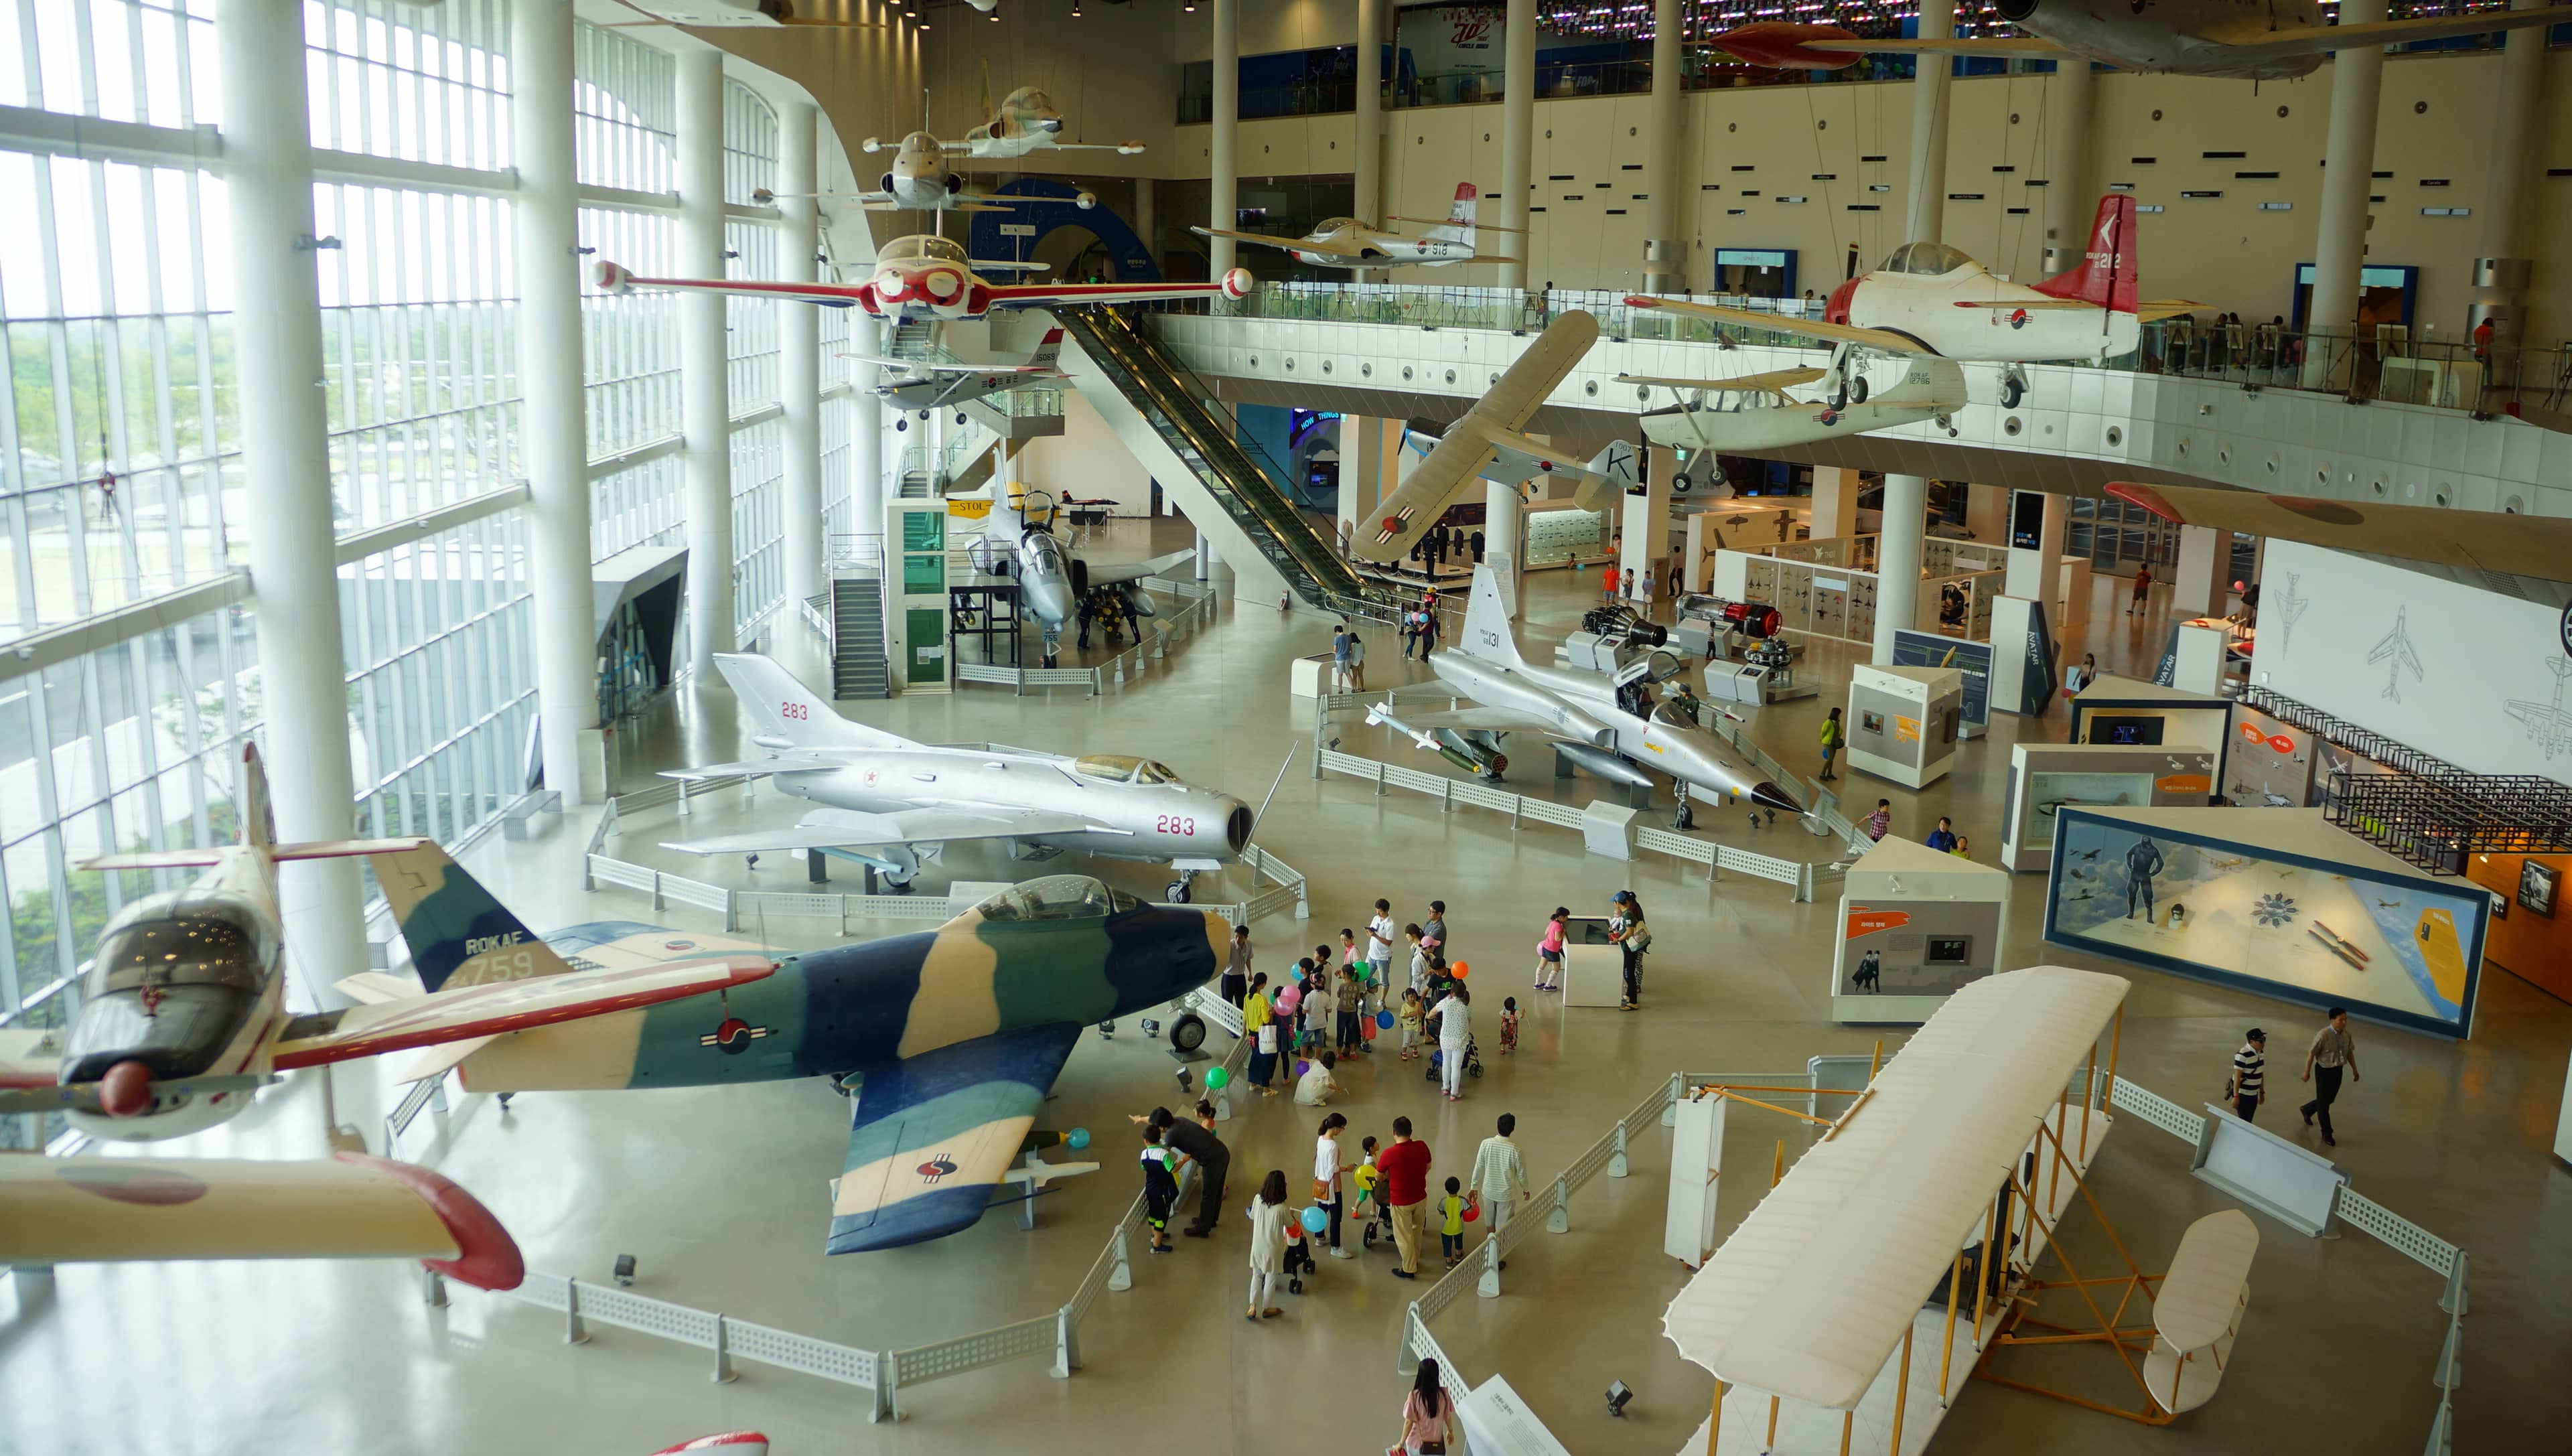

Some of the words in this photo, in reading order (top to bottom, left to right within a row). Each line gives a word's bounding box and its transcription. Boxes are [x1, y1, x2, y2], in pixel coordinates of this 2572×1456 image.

[1432, 242, 1447, 255] 918
[1036, 353, 1056, 362] 15069
[1301, 415, 1315, 431] HOW
[1317, 412, 1340, 421] THINGS
[1607, 448, 1633, 480] K
[960, 502, 985, 511] STOL
[2028, 632, 2039, 665] AVATAR
[2155, 655, 2176, 686] AVATAR
[782, 702, 808, 721] 283
[1157, 815, 1195, 836] 283
[466, 931, 523, 955] ROKAF
[469, 950, 534, 986] 759
